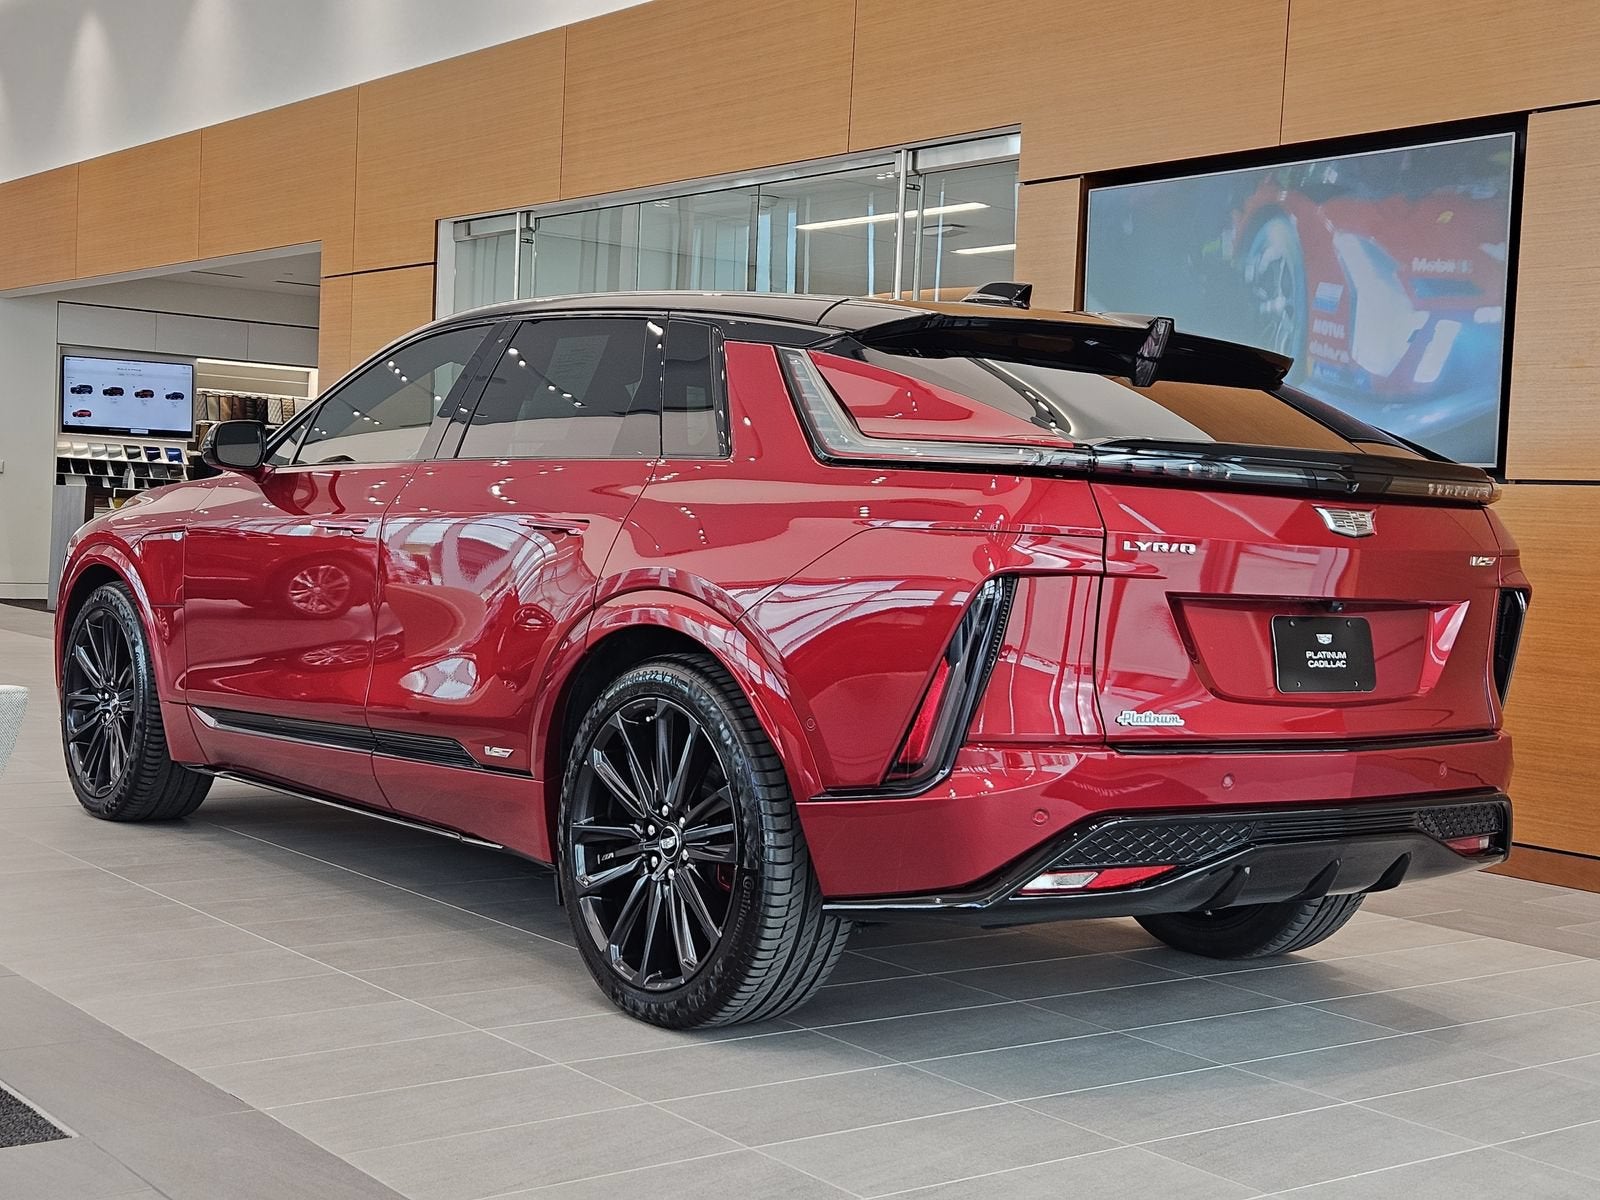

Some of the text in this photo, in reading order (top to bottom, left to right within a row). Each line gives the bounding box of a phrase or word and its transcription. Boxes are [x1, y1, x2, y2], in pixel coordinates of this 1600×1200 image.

[1305, 651, 1347, 659] PLATINUM
[1307, 660, 1347, 668] CADILLAC
[1116, 710, 1185, 726] Platinum
